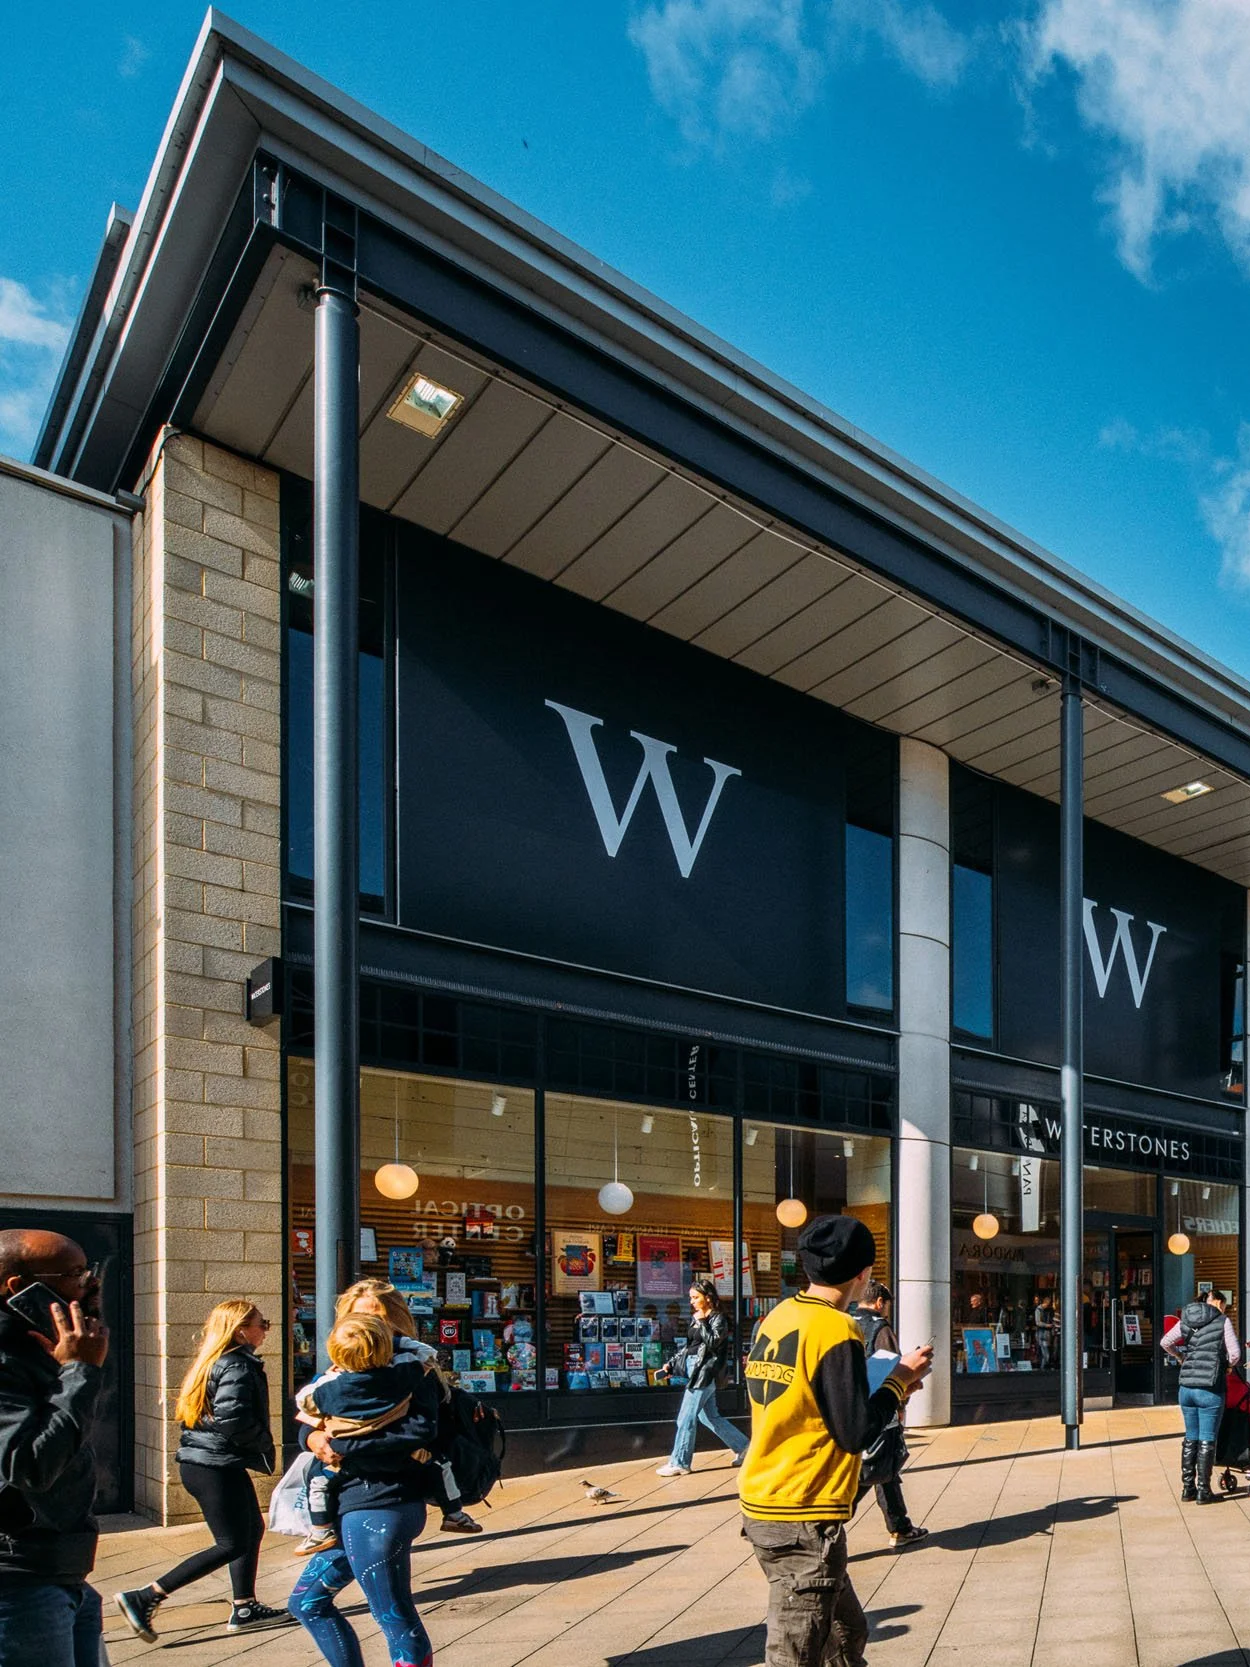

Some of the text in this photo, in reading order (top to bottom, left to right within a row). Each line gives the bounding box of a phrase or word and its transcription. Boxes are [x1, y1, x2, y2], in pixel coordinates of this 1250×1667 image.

[544, 698, 742, 878] W
[1082, 897, 1167, 1009] W
[1045, 1117, 1191, 1161] WERSTONES
